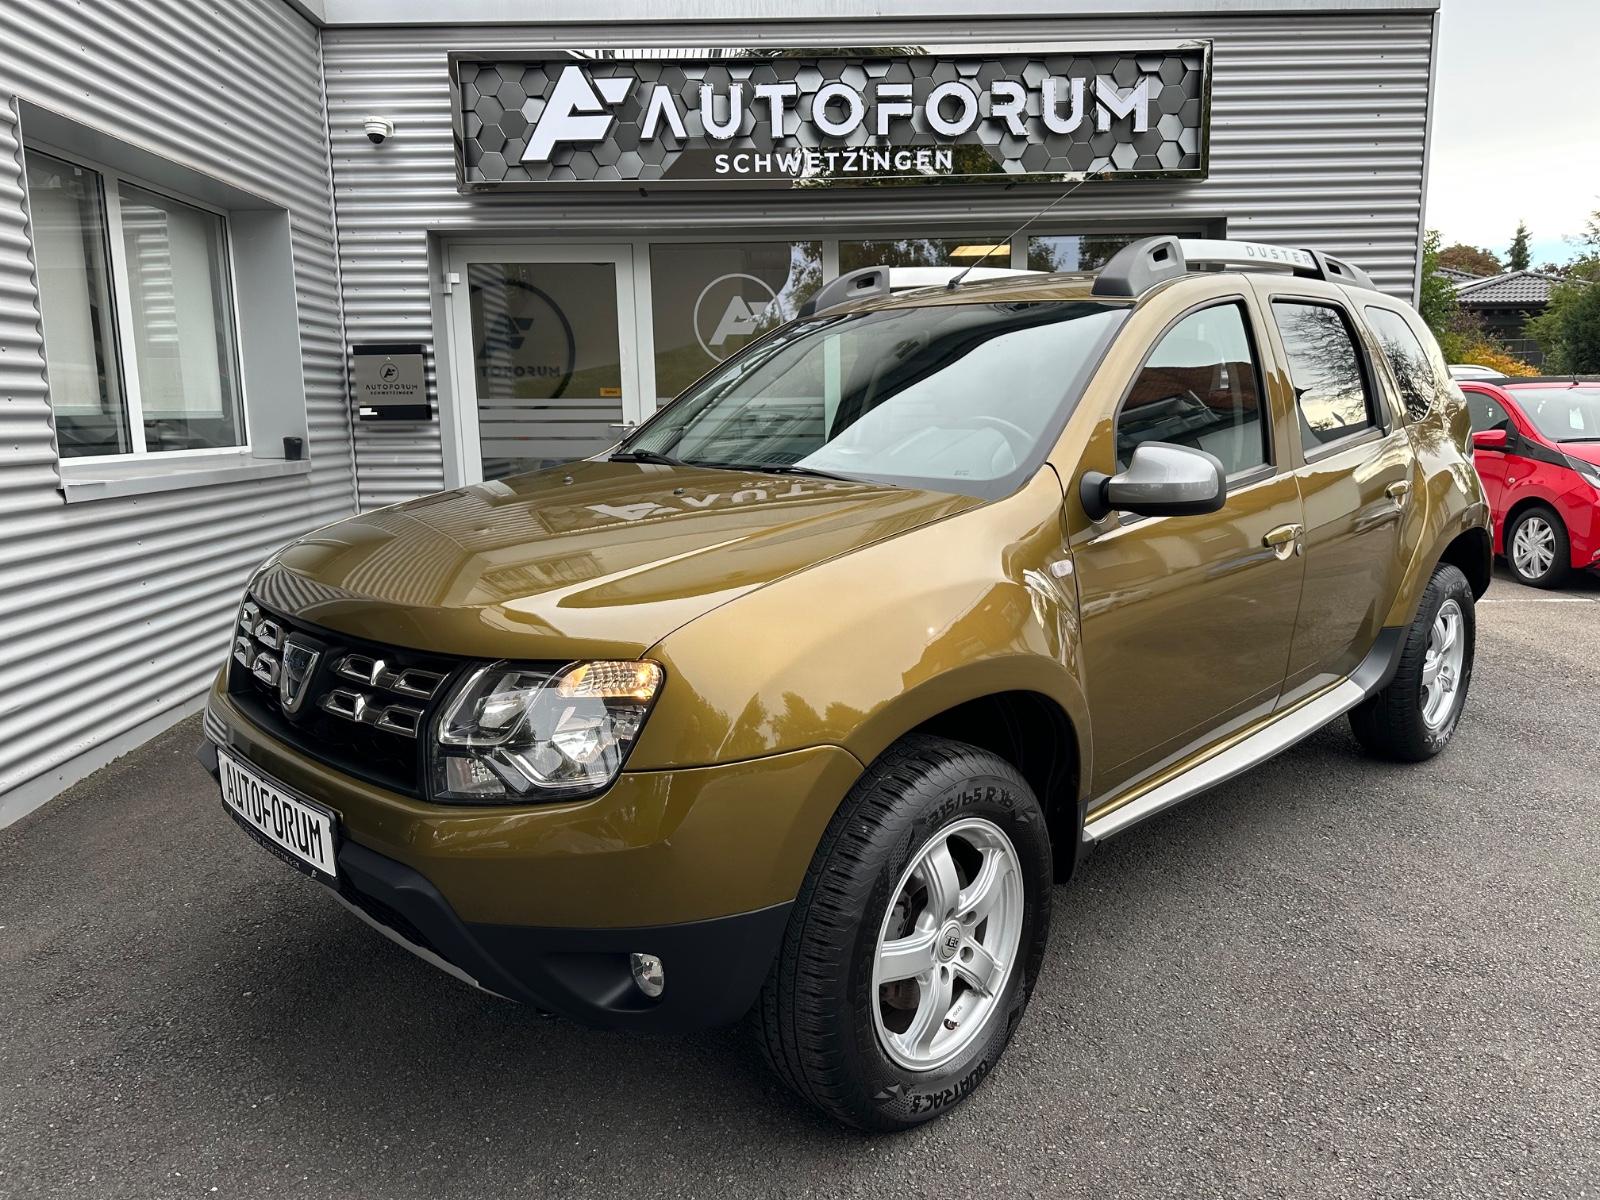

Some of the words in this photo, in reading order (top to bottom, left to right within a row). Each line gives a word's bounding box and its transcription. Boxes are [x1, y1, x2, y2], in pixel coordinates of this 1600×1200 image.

[640, 75, 1149, 139] AUTOFORUM
[715, 151, 953, 174] SCHWETZINGEN
[1247, 246, 1311, 264] DUSTER
[226, 762, 325, 865] AUTOFORUM
